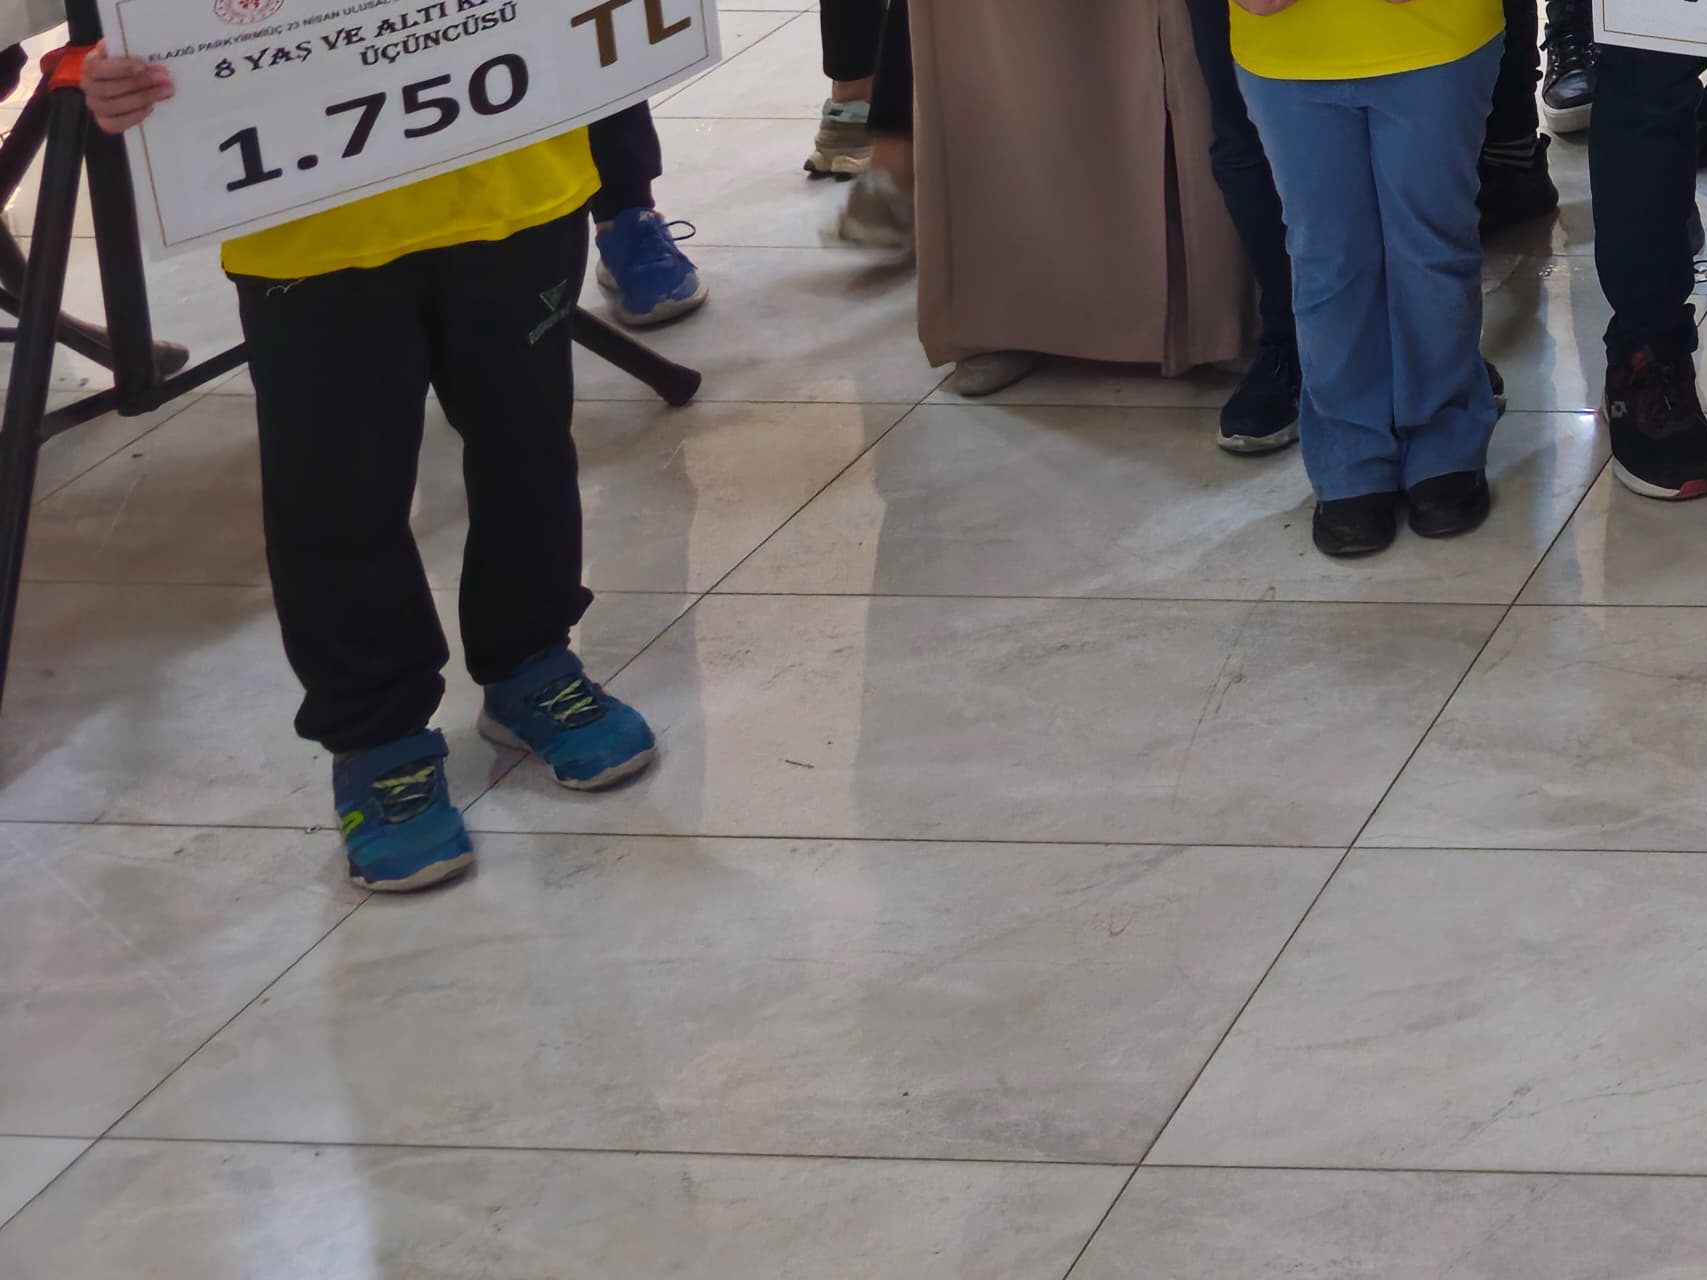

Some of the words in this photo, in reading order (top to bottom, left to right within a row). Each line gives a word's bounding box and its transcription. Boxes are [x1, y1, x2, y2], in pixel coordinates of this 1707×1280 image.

[214, 57, 236, 79] 8
[248, 38, 312, 74] YAŞ
[320, 26, 364, 53] VE
[376, 2, 448, 37] ALTI
[360, 3, 518, 70] ÜÇÜNCÜSÜ
[219, 53, 530, 192] 1.750
